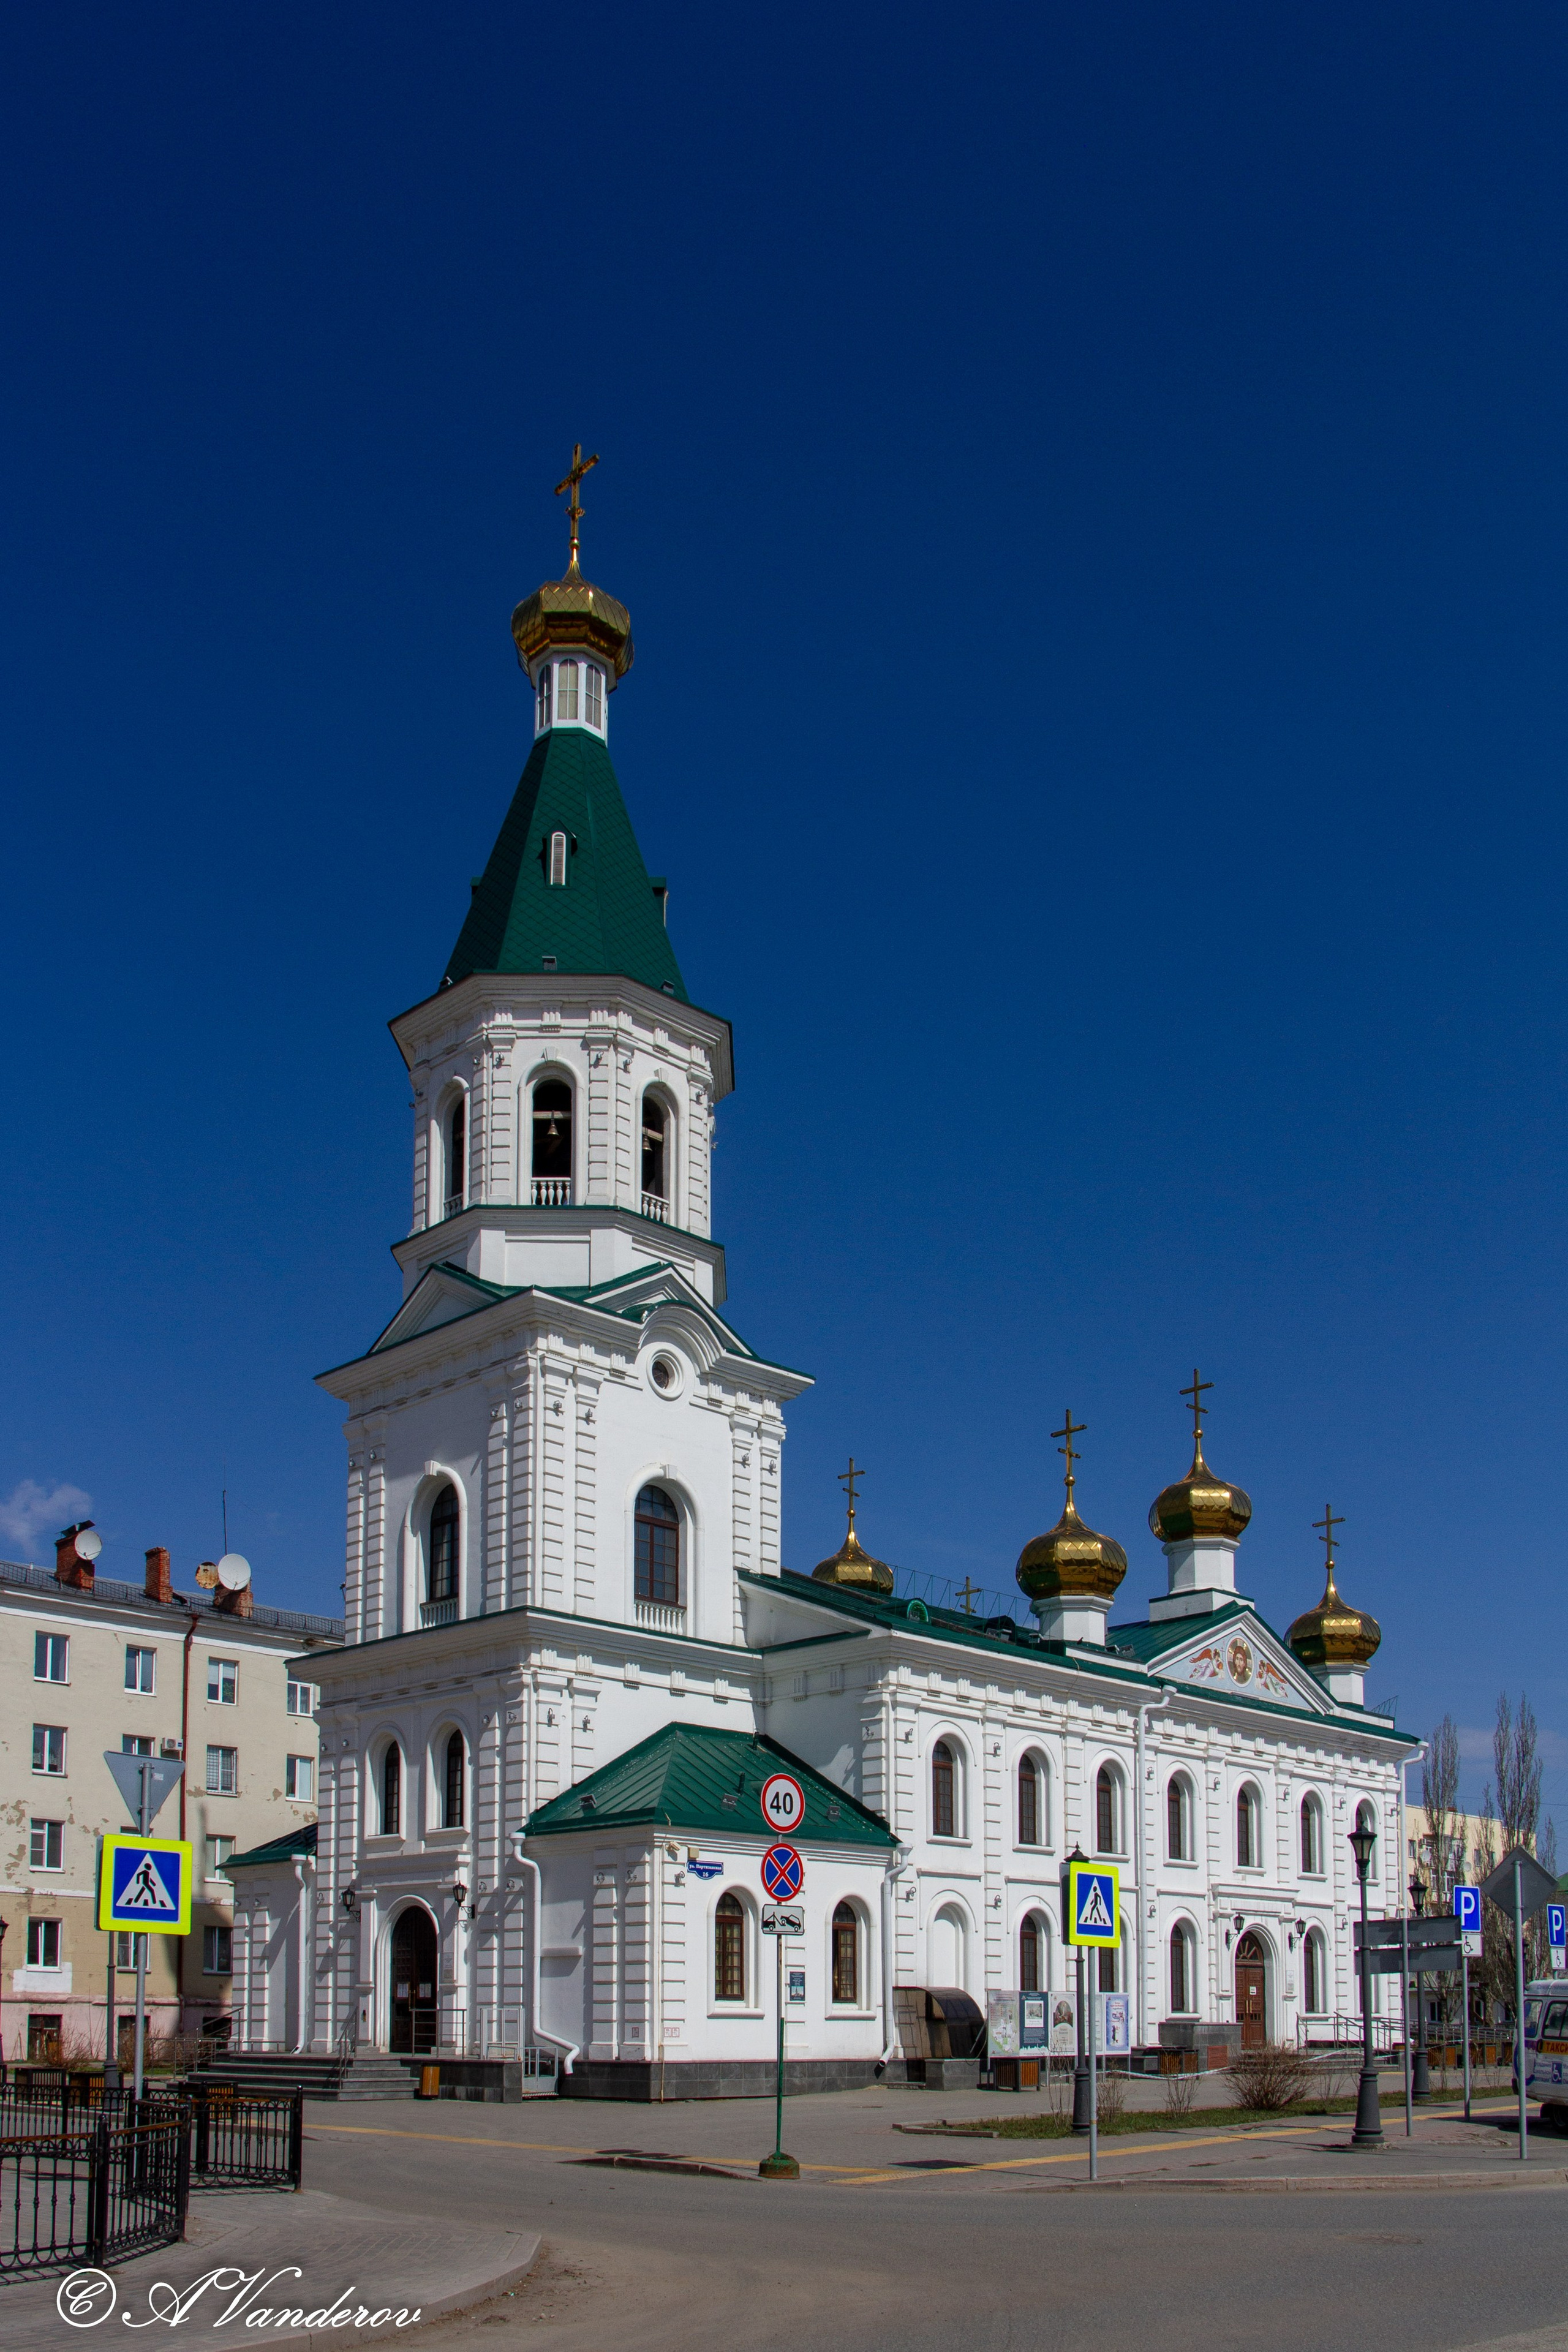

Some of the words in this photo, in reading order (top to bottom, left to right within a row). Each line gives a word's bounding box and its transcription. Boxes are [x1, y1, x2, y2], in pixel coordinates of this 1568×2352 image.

[770, 1792, 794, 1815] 40
[1461, 1891, 1475, 1926] P
[1552, 1910, 1562, 1942] P
